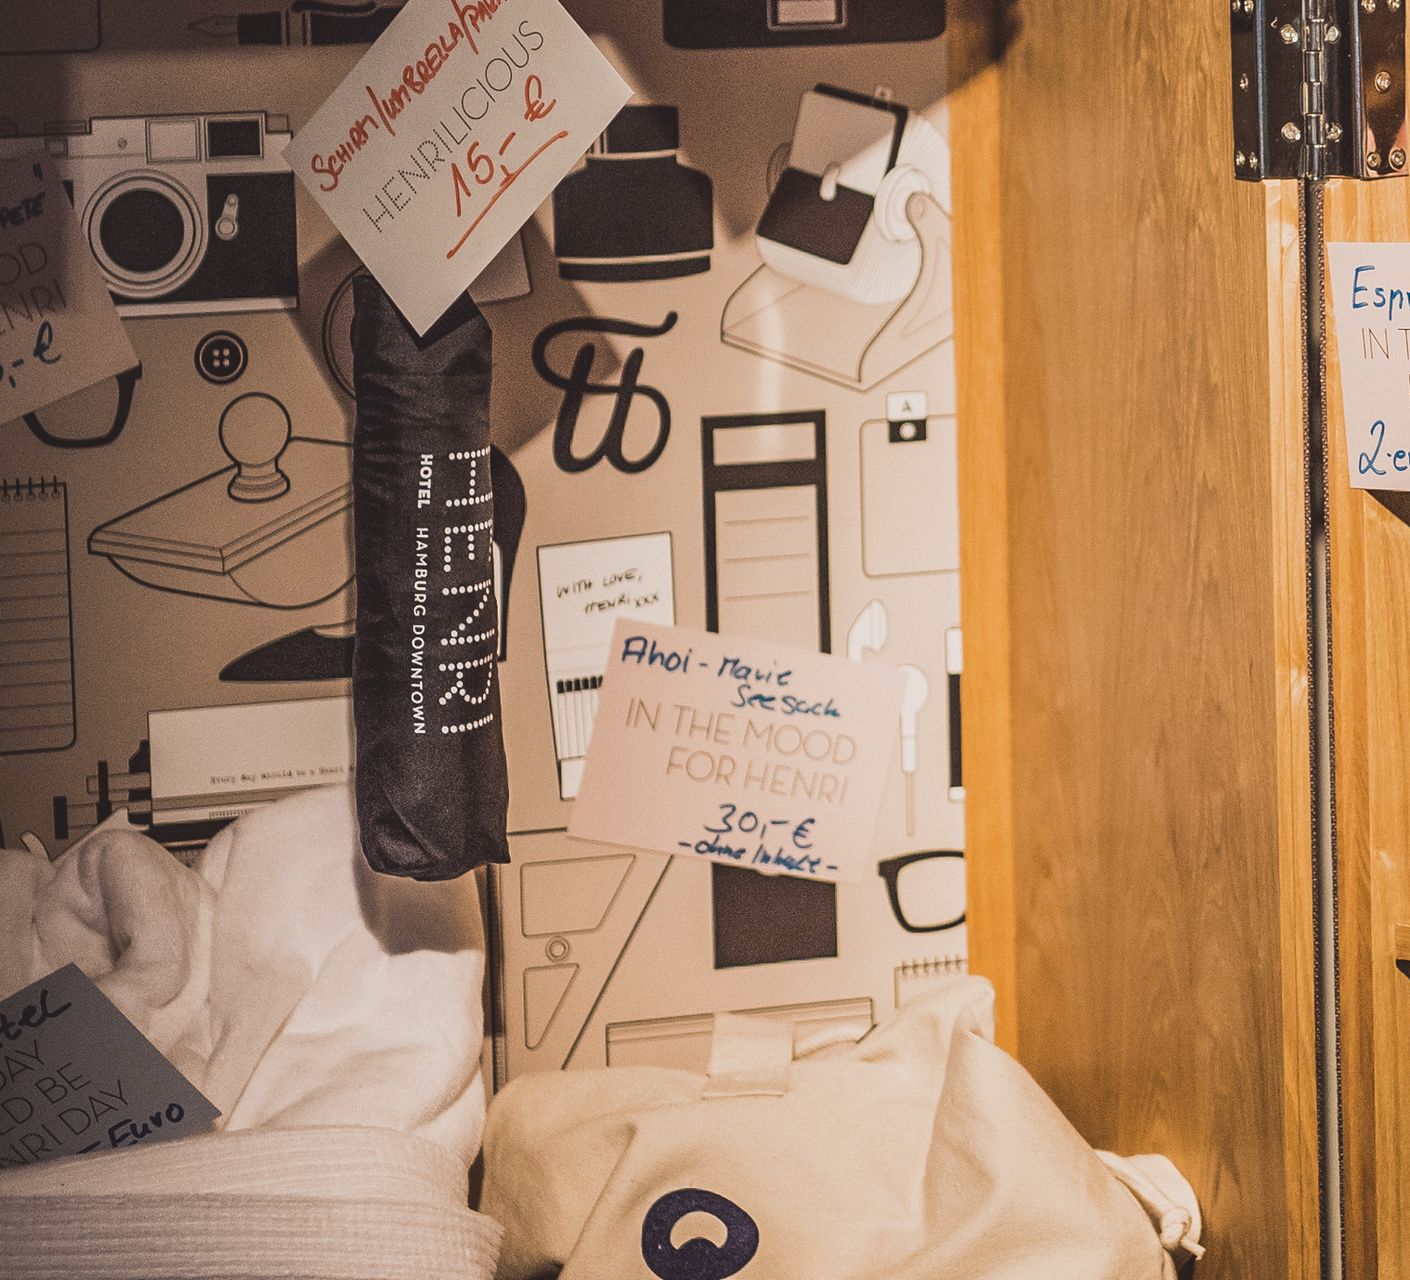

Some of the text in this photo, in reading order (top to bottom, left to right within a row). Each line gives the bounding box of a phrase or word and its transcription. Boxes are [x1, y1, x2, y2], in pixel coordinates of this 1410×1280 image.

[362, 20, 545, 233] HENRILICIOUS
[1361, 328, 1390, 360] IN
[418, 453, 434, 509] HOTEL
[439, 444, 494, 735] HENRI
[557, 577, 594, 599] WITH
[584, 594, 630, 615] HENRI
[410, 527, 430, 735] HAMBURG DOWNTOWN
[625, 697, 857, 766] IN THE MOOD
[665, 746, 849, 805] FOR HENRI
[34, 1062, 92, 1104] BE
[57, 1078, 129, 1136] DAY
[107, 1103, 186, 1149] Euro
